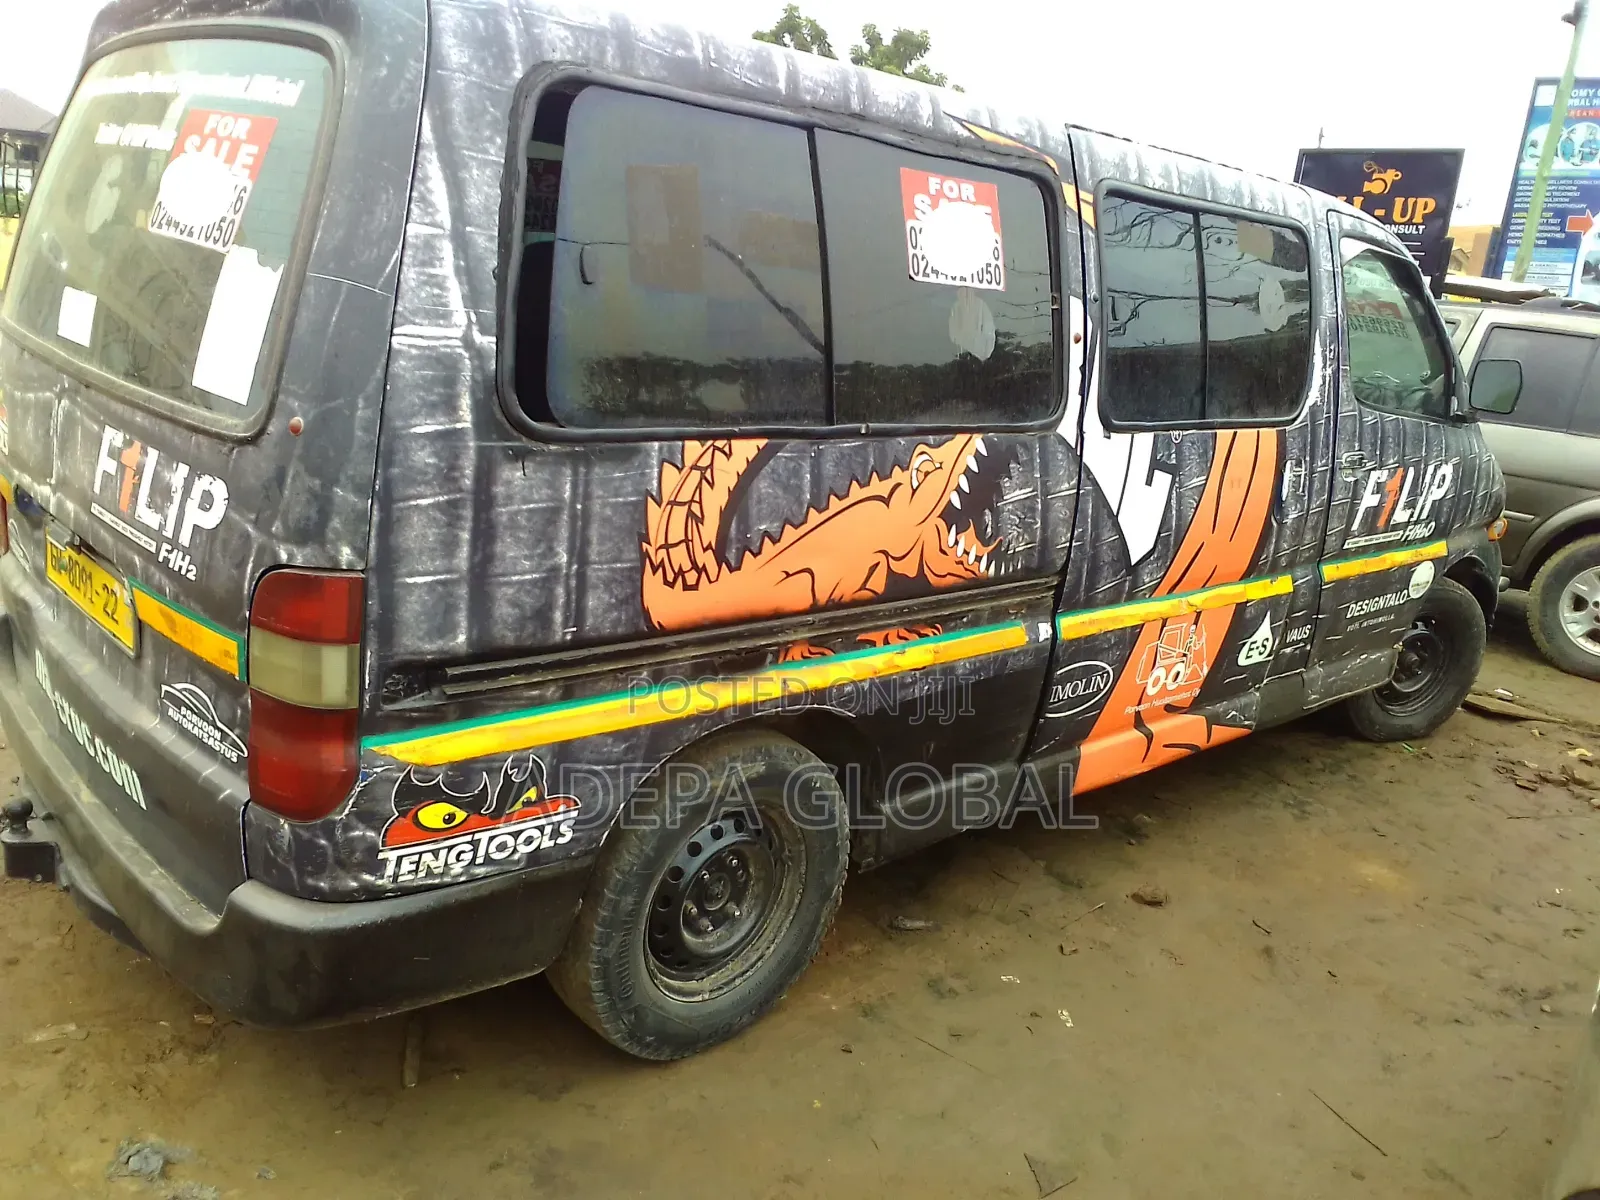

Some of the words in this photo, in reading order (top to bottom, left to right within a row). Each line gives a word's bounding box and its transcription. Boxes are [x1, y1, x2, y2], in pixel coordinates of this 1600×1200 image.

[203, 113, 252, 141] FOR
[928, 176, 976, 202] FOR
[1392, 197, 1436, 223] UP
[1346, 589, 1408, 619] DESIGNTALO
[168, 707, 238, 763] AUTOKATSASTUS
[181, 706, 222, 741] PORVOON
